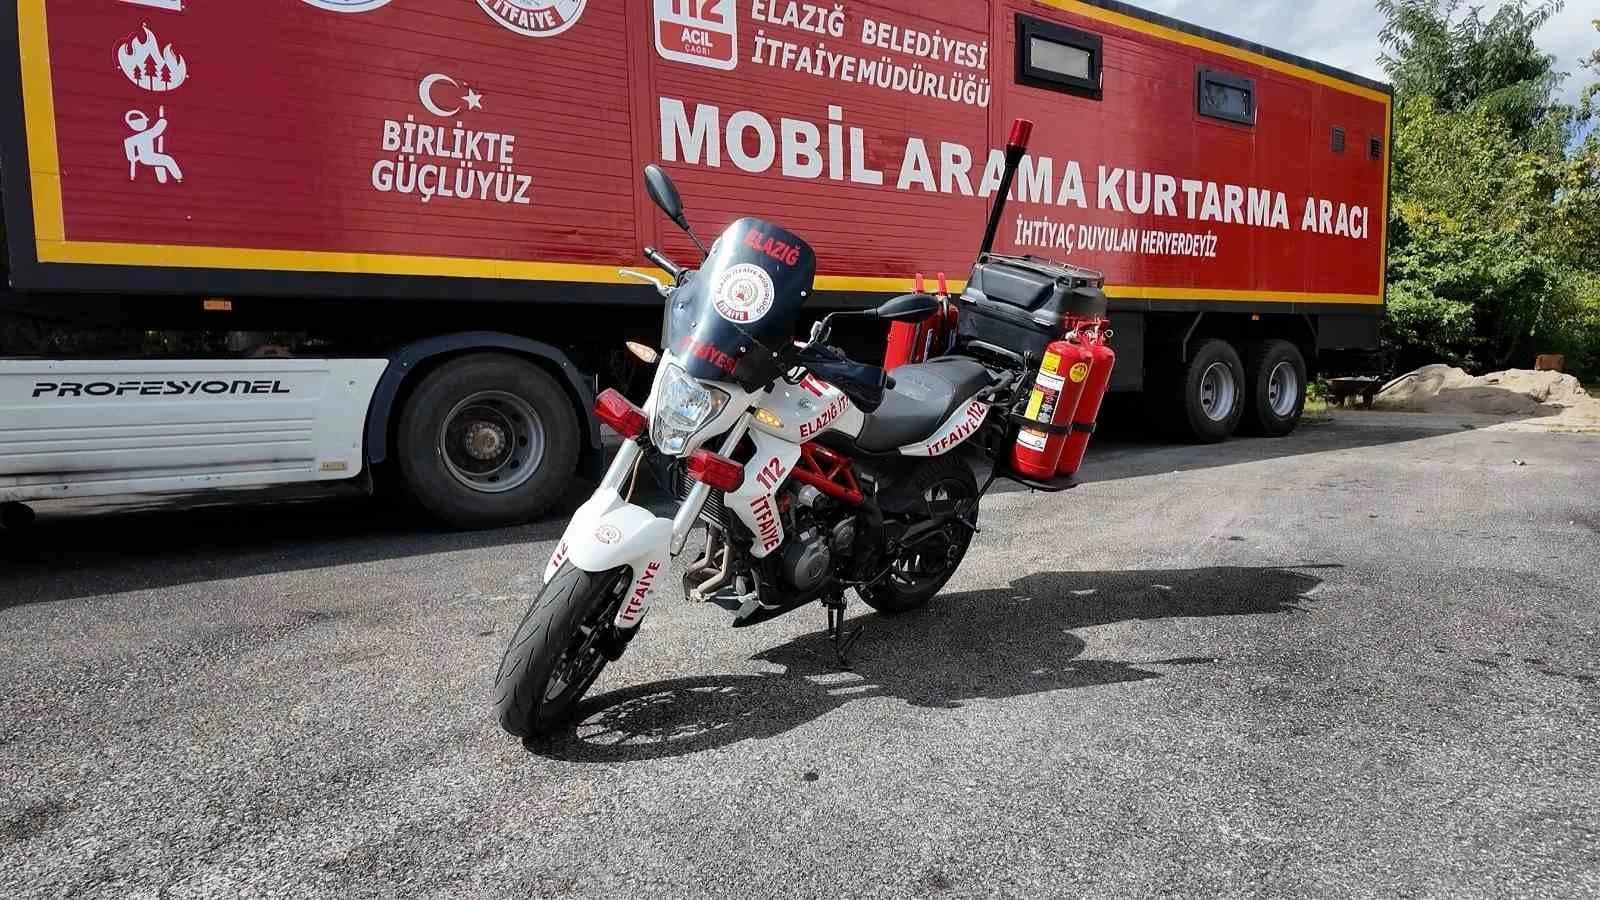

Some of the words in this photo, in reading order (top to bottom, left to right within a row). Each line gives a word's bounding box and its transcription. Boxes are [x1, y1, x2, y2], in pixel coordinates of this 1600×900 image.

[751, 0, 845, 37] ELAZIĞ
[861, 19, 988, 70] BELEDİYESİ
[751, 30, 856, 82] İTFAİYE
[856, 58, 990, 108] MÜDÜRLÜĞÜ
[382, 114, 515, 163] BİRLİKTE
[371, 155, 532, 204] GÜÇLÜYÜZ
[659, 97, 883, 186] MOBİL
[896, 137, 1088, 209] ARAMA
[1097, 165, 1290, 230] KURTARMA
[1301, 196, 1368, 239] ARACI
[1014, 213, 1075, 255] İHTİYAÇ
[1077, 224, 1138, 251] DUYULAN
[1140, 230, 1218, 257] HERYERDEYİZ
[32, 380, 290, 398] PROFESYONEL
[800, 402, 838, 437] ELAZIĞ
[926, 418, 978, 456] İTFAİYE
[966, 401, 985, 421] 112
[756, 457, 786, 489] 112
[750, 493, 779, 551] İTFAİYE
[552, 542, 568, 568] 112
[620, 561, 661, 621] İTFAİYE
